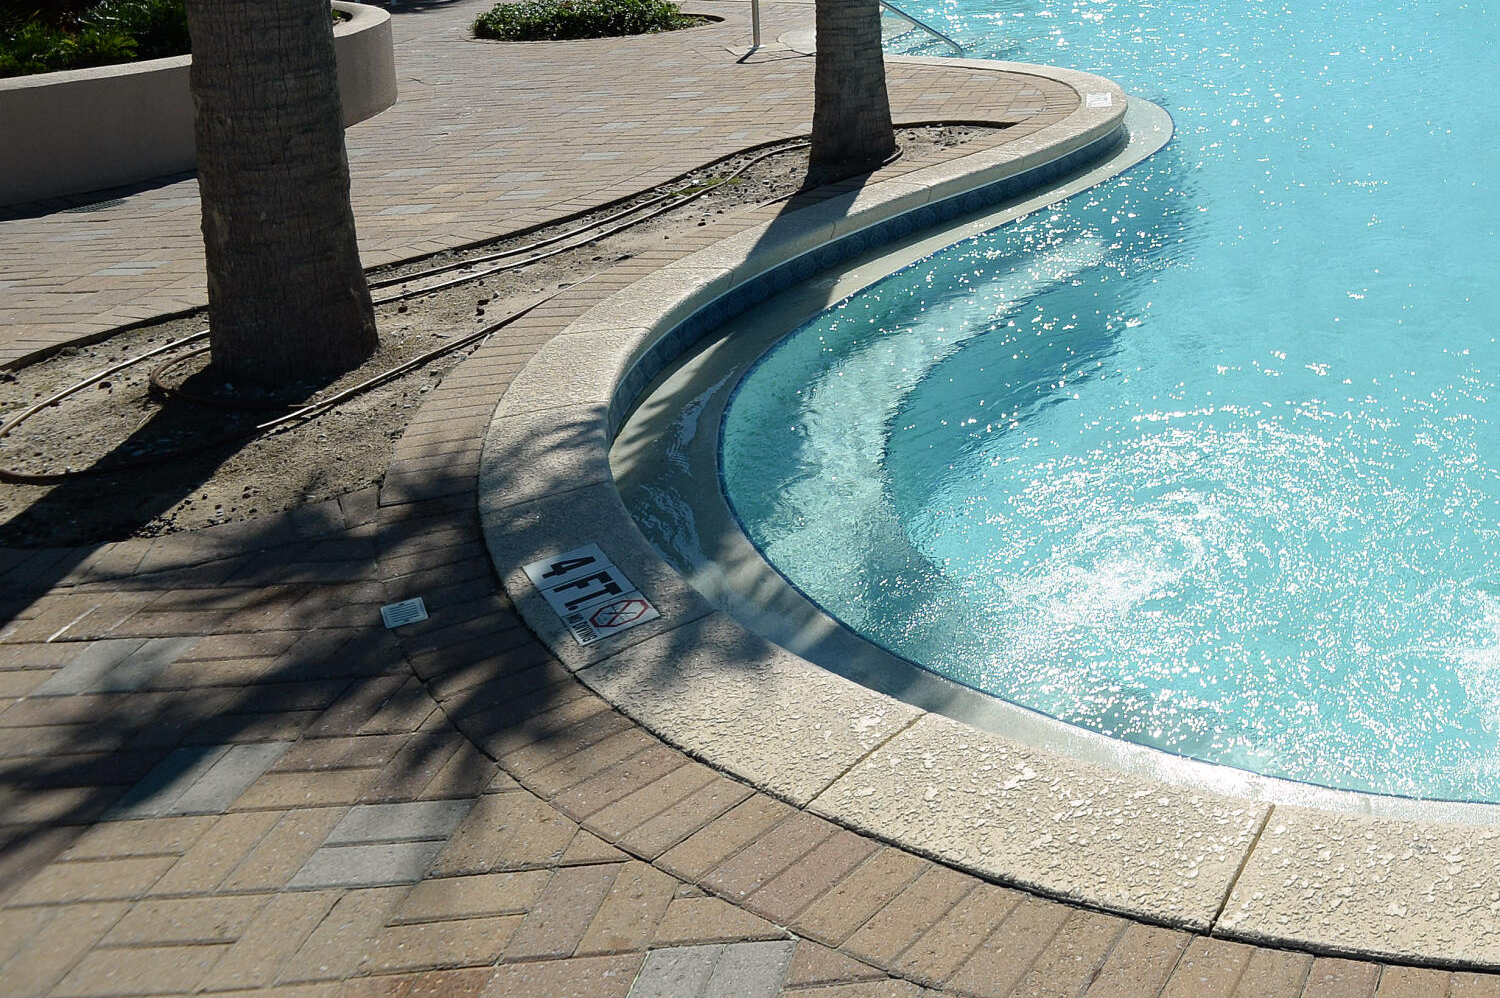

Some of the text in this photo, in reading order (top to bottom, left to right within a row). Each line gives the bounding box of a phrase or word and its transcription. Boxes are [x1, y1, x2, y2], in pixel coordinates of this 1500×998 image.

[542, 556, 623, 611] 4 FT.
[566, 613, 598, 643] NO DIVING
